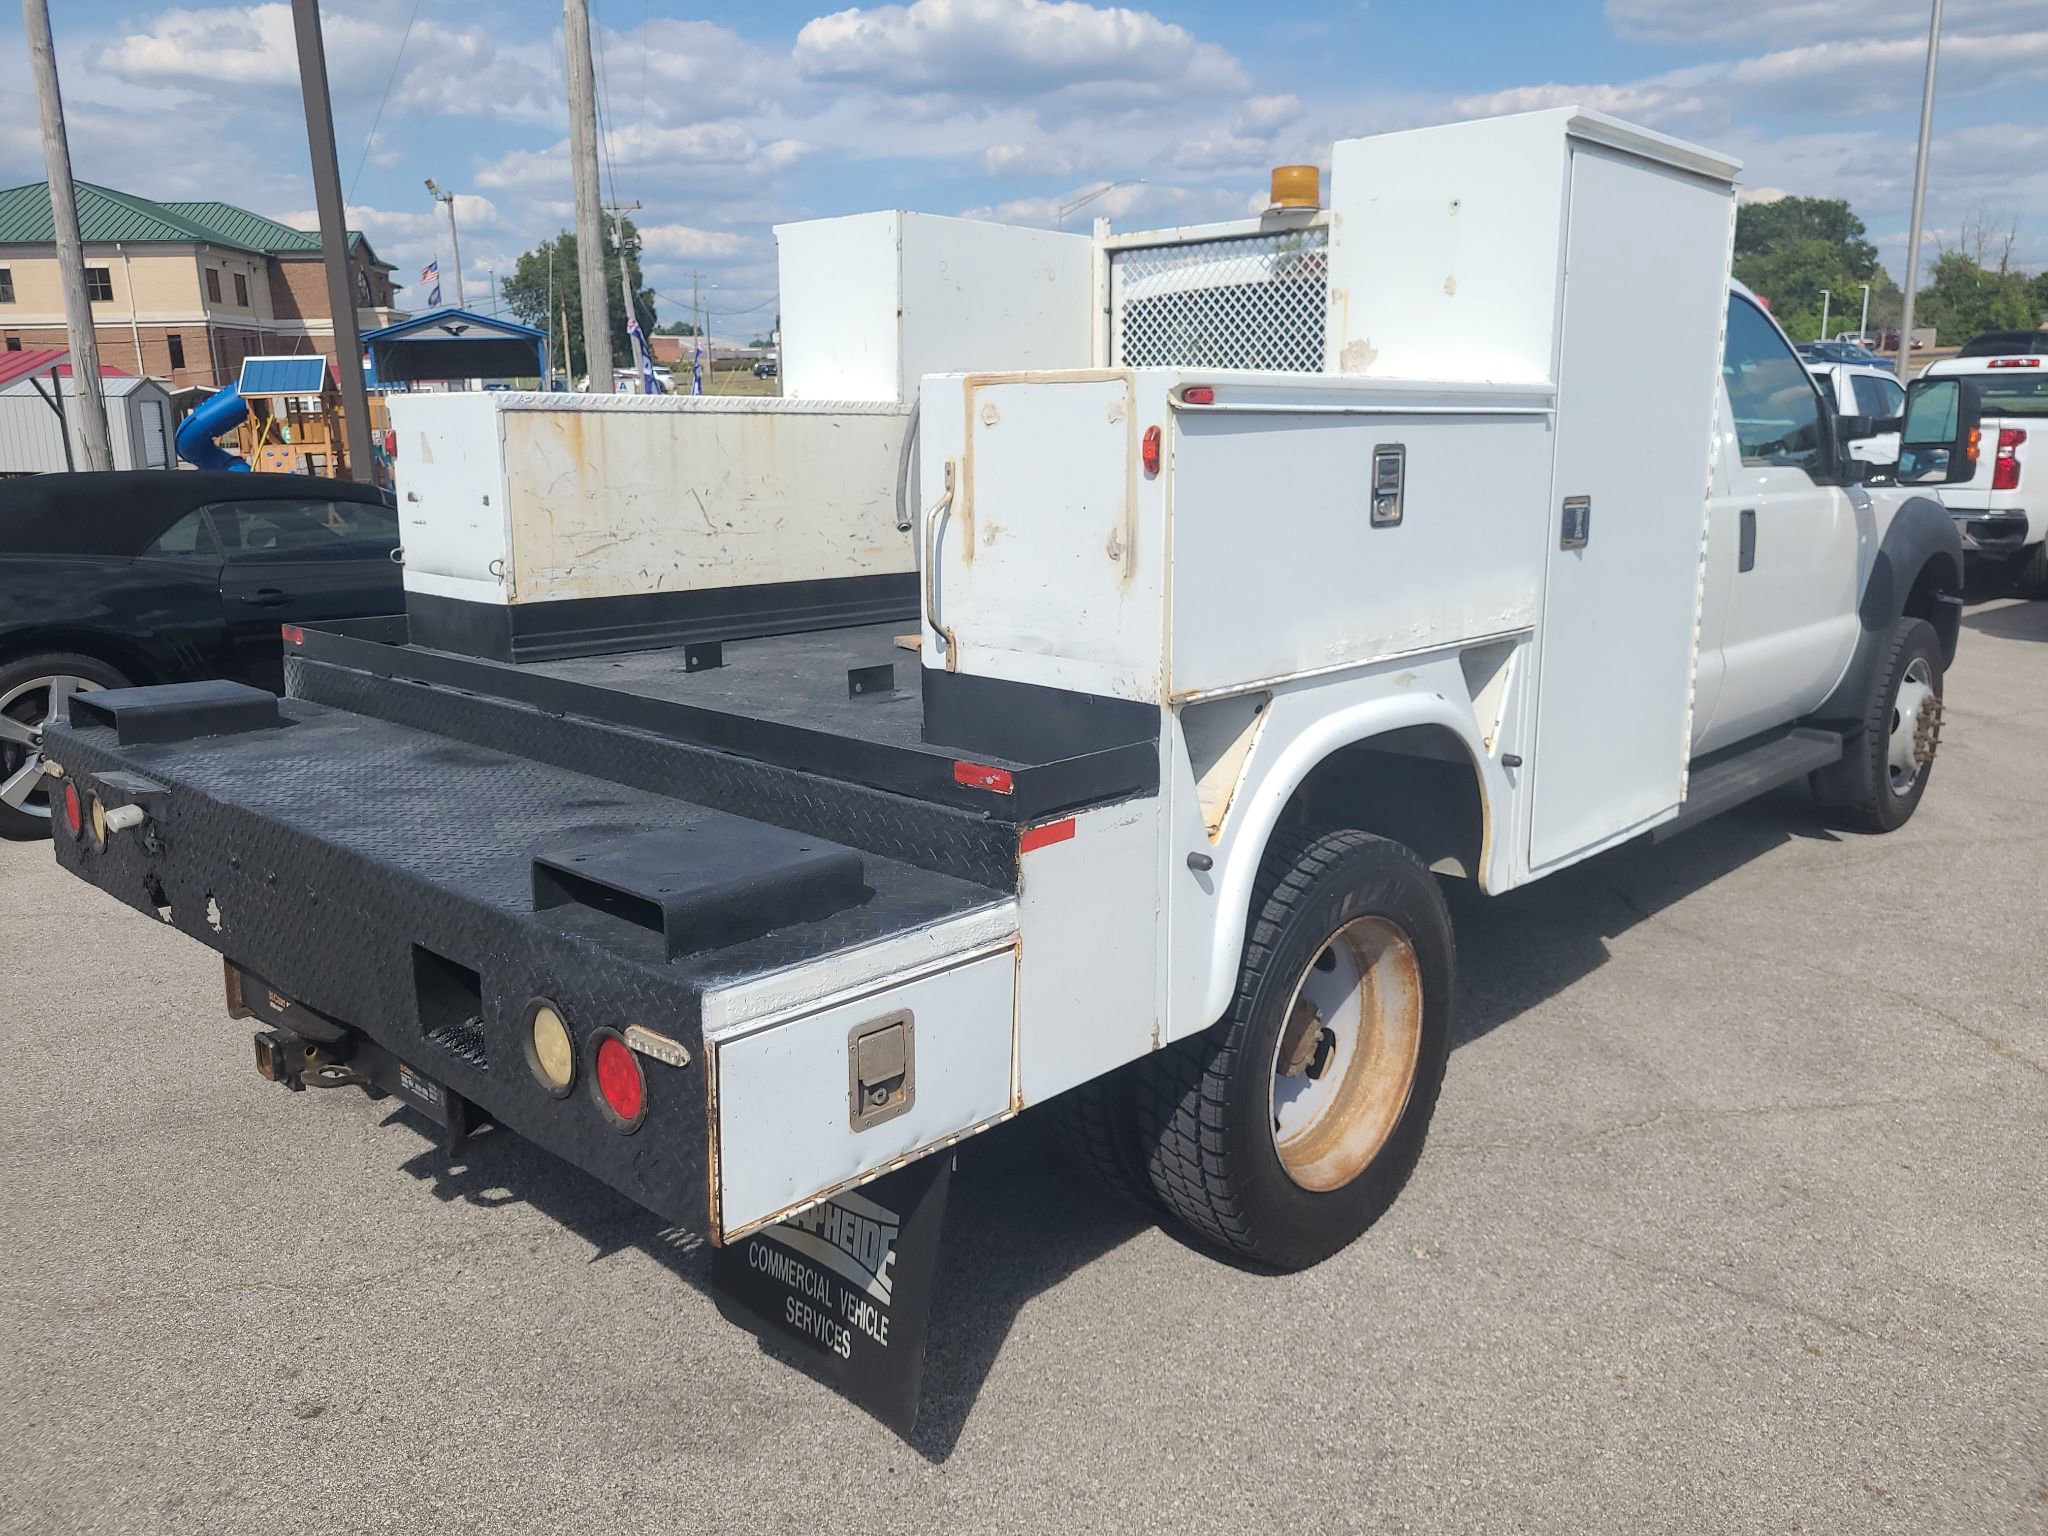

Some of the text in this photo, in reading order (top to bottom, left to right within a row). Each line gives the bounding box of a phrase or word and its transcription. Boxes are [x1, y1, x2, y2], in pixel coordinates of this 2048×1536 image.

[749, 1241, 889, 1346] COMMERCIAL VEHICLE
[785, 1201, 899, 1294] PHEIDE
[786, 1295, 851, 1359] SERVICES
